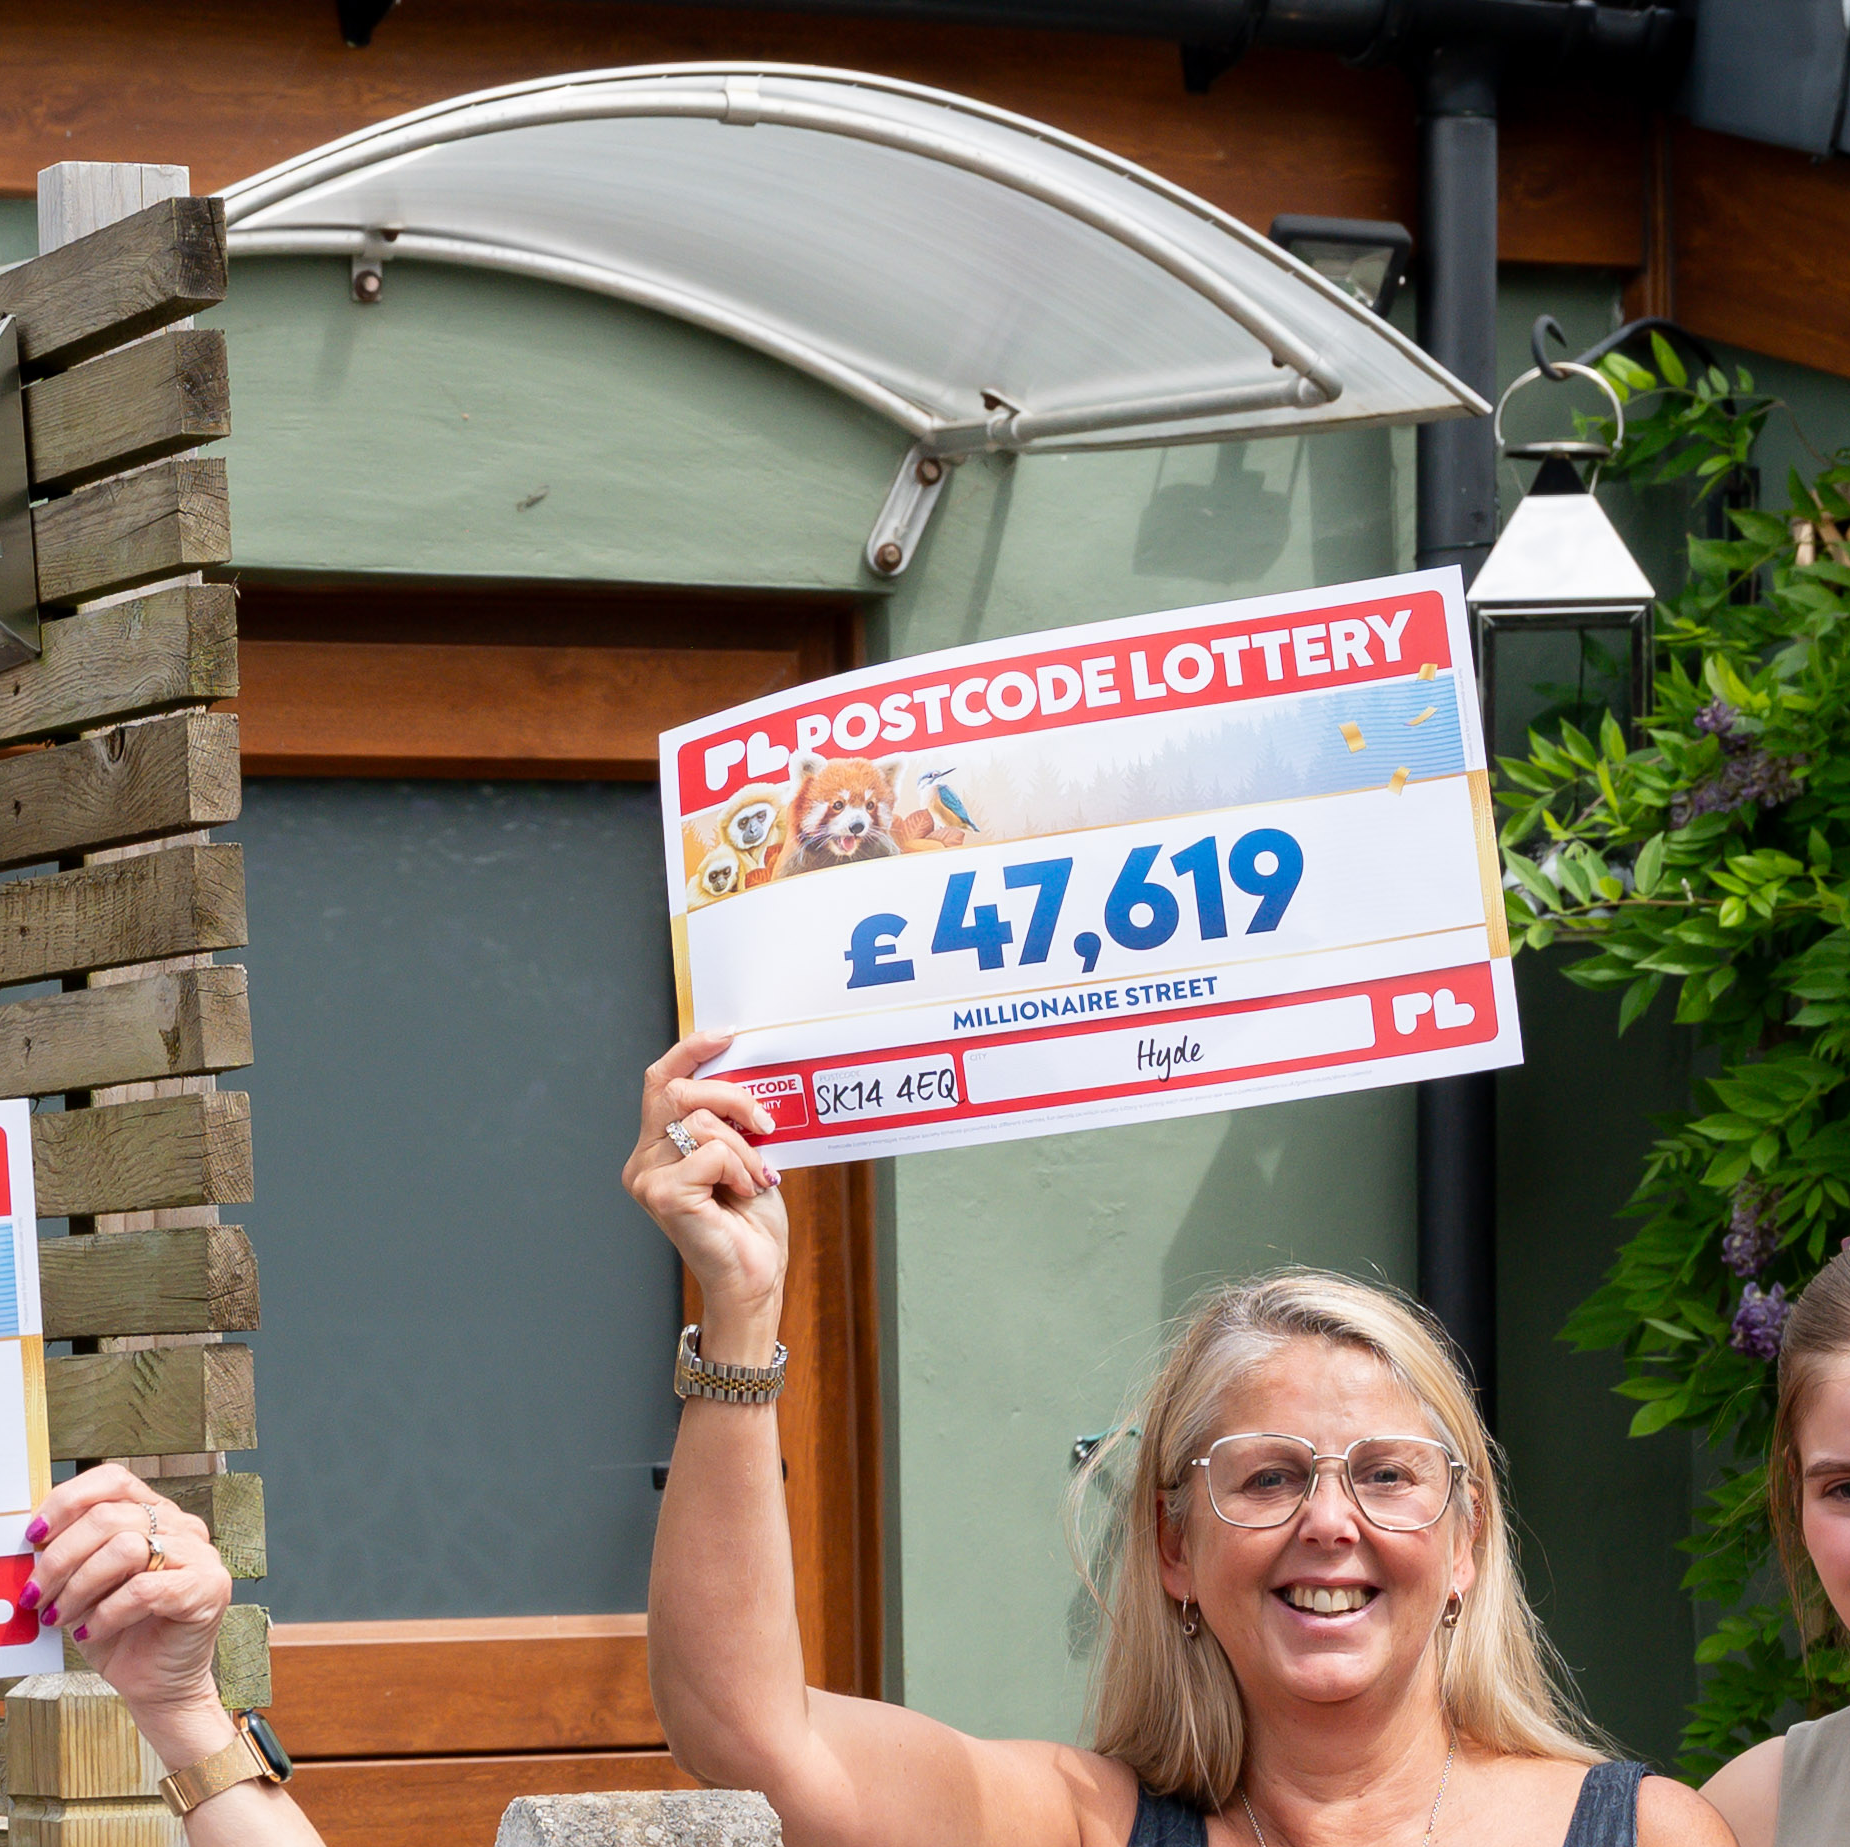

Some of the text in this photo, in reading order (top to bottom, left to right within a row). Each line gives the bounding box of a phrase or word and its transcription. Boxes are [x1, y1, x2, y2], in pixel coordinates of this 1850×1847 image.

[796, 655, 1121, 753] POSTCODE
[1130, 609, 1412, 701] LOTTERY
[953, 976, 1218, 1031] MILLIONAIRE STREET
[1137, 1035, 1205, 1083] Hyde
[742, 1078, 797, 1096] TCODE
[815, 1068, 966, 1116] SK14 4EQ
